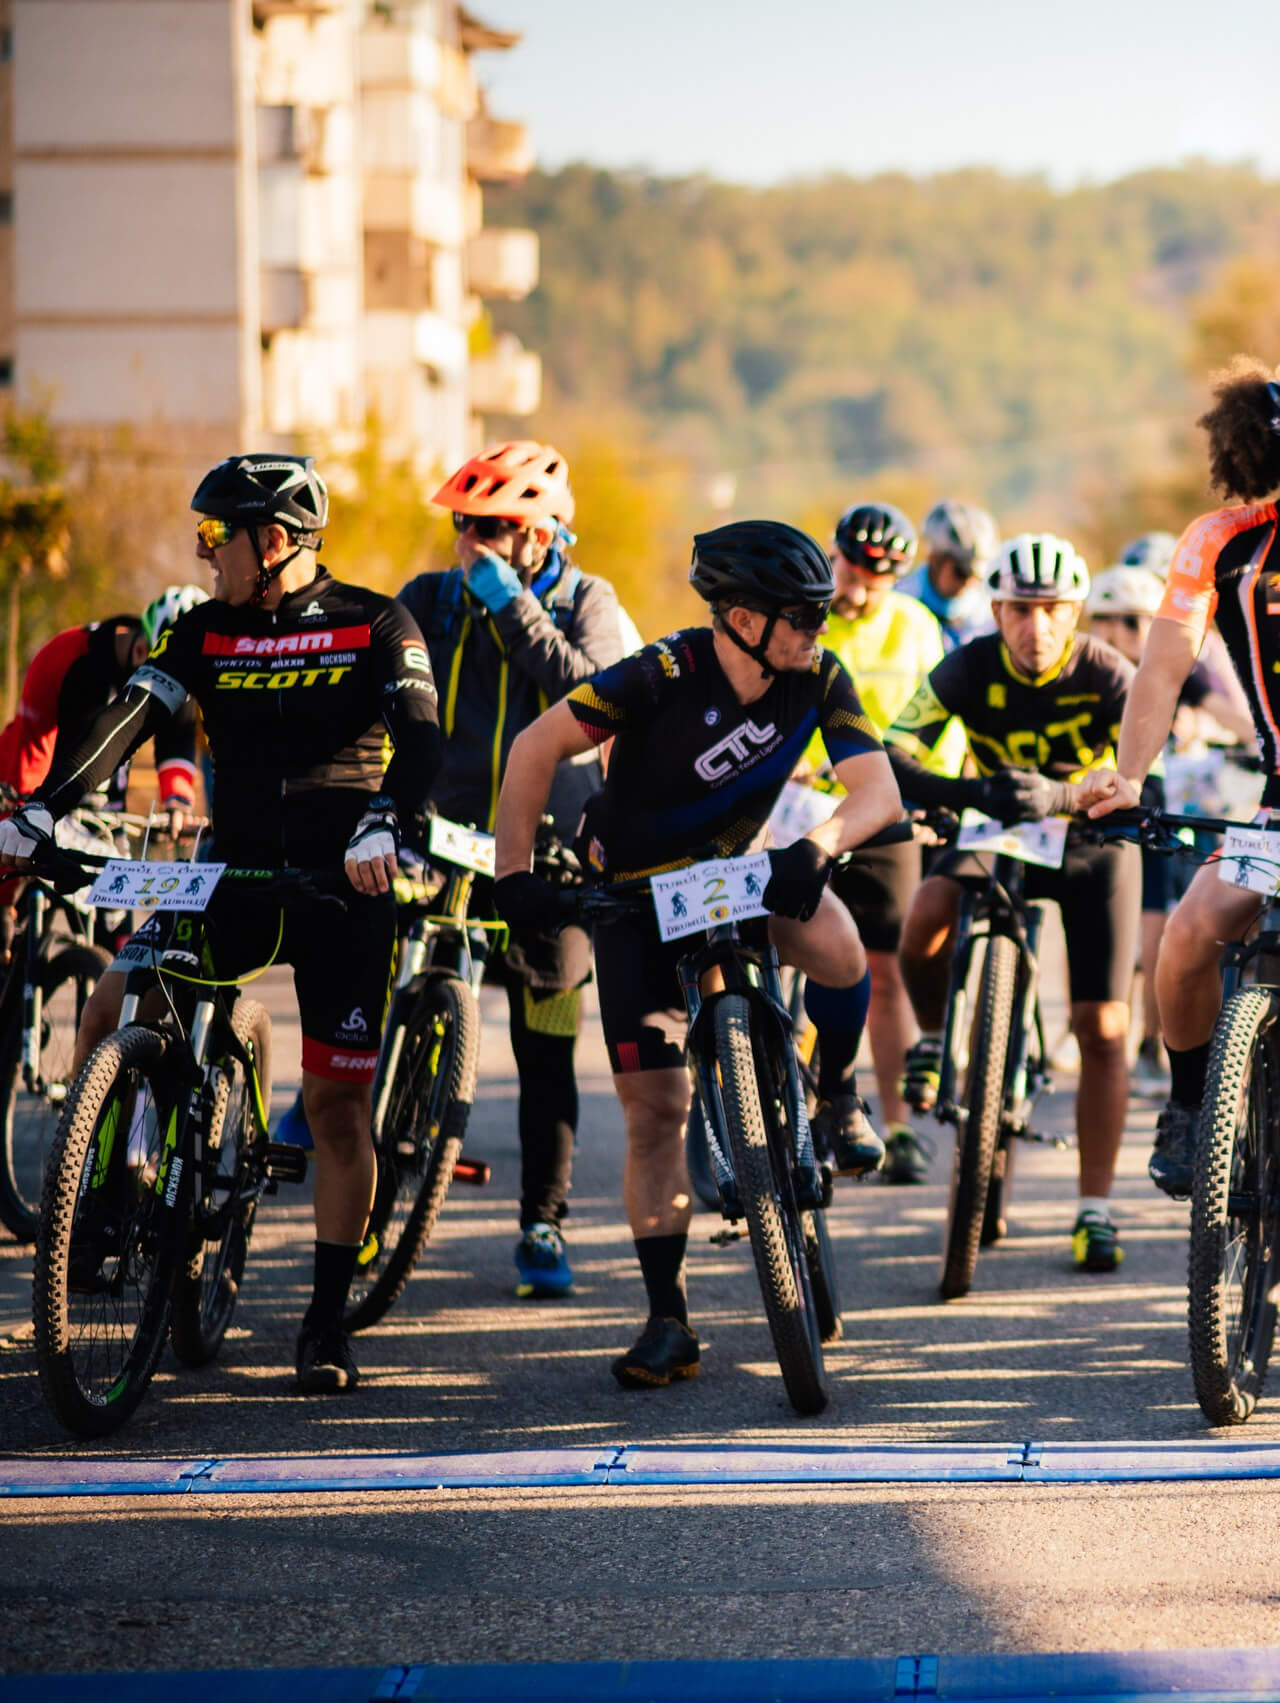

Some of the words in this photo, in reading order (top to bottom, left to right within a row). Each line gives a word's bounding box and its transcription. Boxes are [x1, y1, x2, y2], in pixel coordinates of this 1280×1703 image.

[234, 632, 334, 654] SRAM
[215, 666, 353, 690] SCOTT
[694, 718, 777, 781] CTL
[134, 877, 180, 895] 19
[702, 878, 730, 905] 2
[165, 1156, 184, 1208] ROCKSHOX
